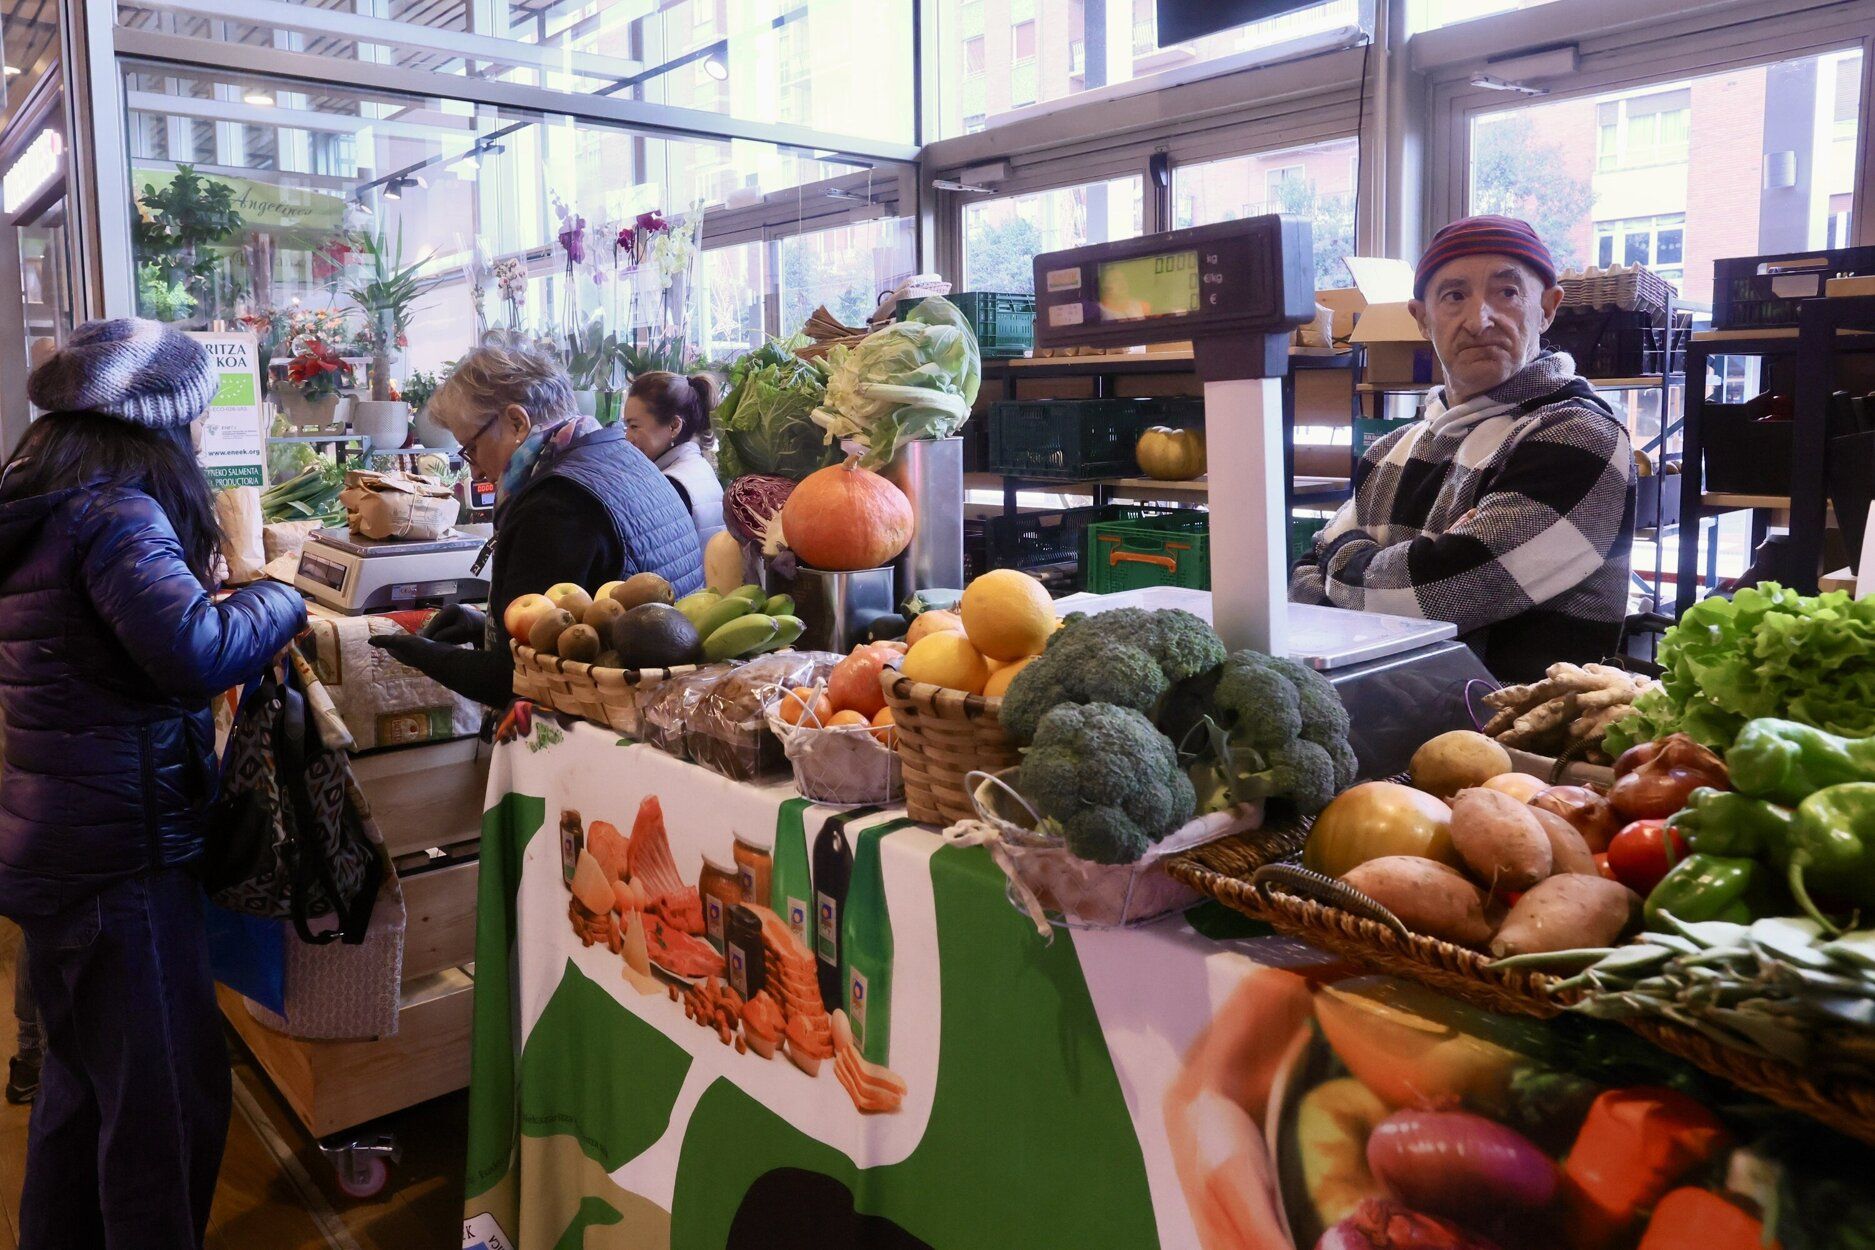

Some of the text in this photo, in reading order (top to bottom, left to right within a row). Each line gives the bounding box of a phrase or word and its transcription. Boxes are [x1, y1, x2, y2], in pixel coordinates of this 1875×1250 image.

[1206, 255, 1217, 264] kg
[1210, 294, 1217, 304] €
[204, 343, 247, 355] RITZA
[216, 356, 248, 368] KOA
[228, 467, 259, 476] SALMENTA
[462, 1224, 476, 1240] K
[488, 1234, 506, 1250] ICA
